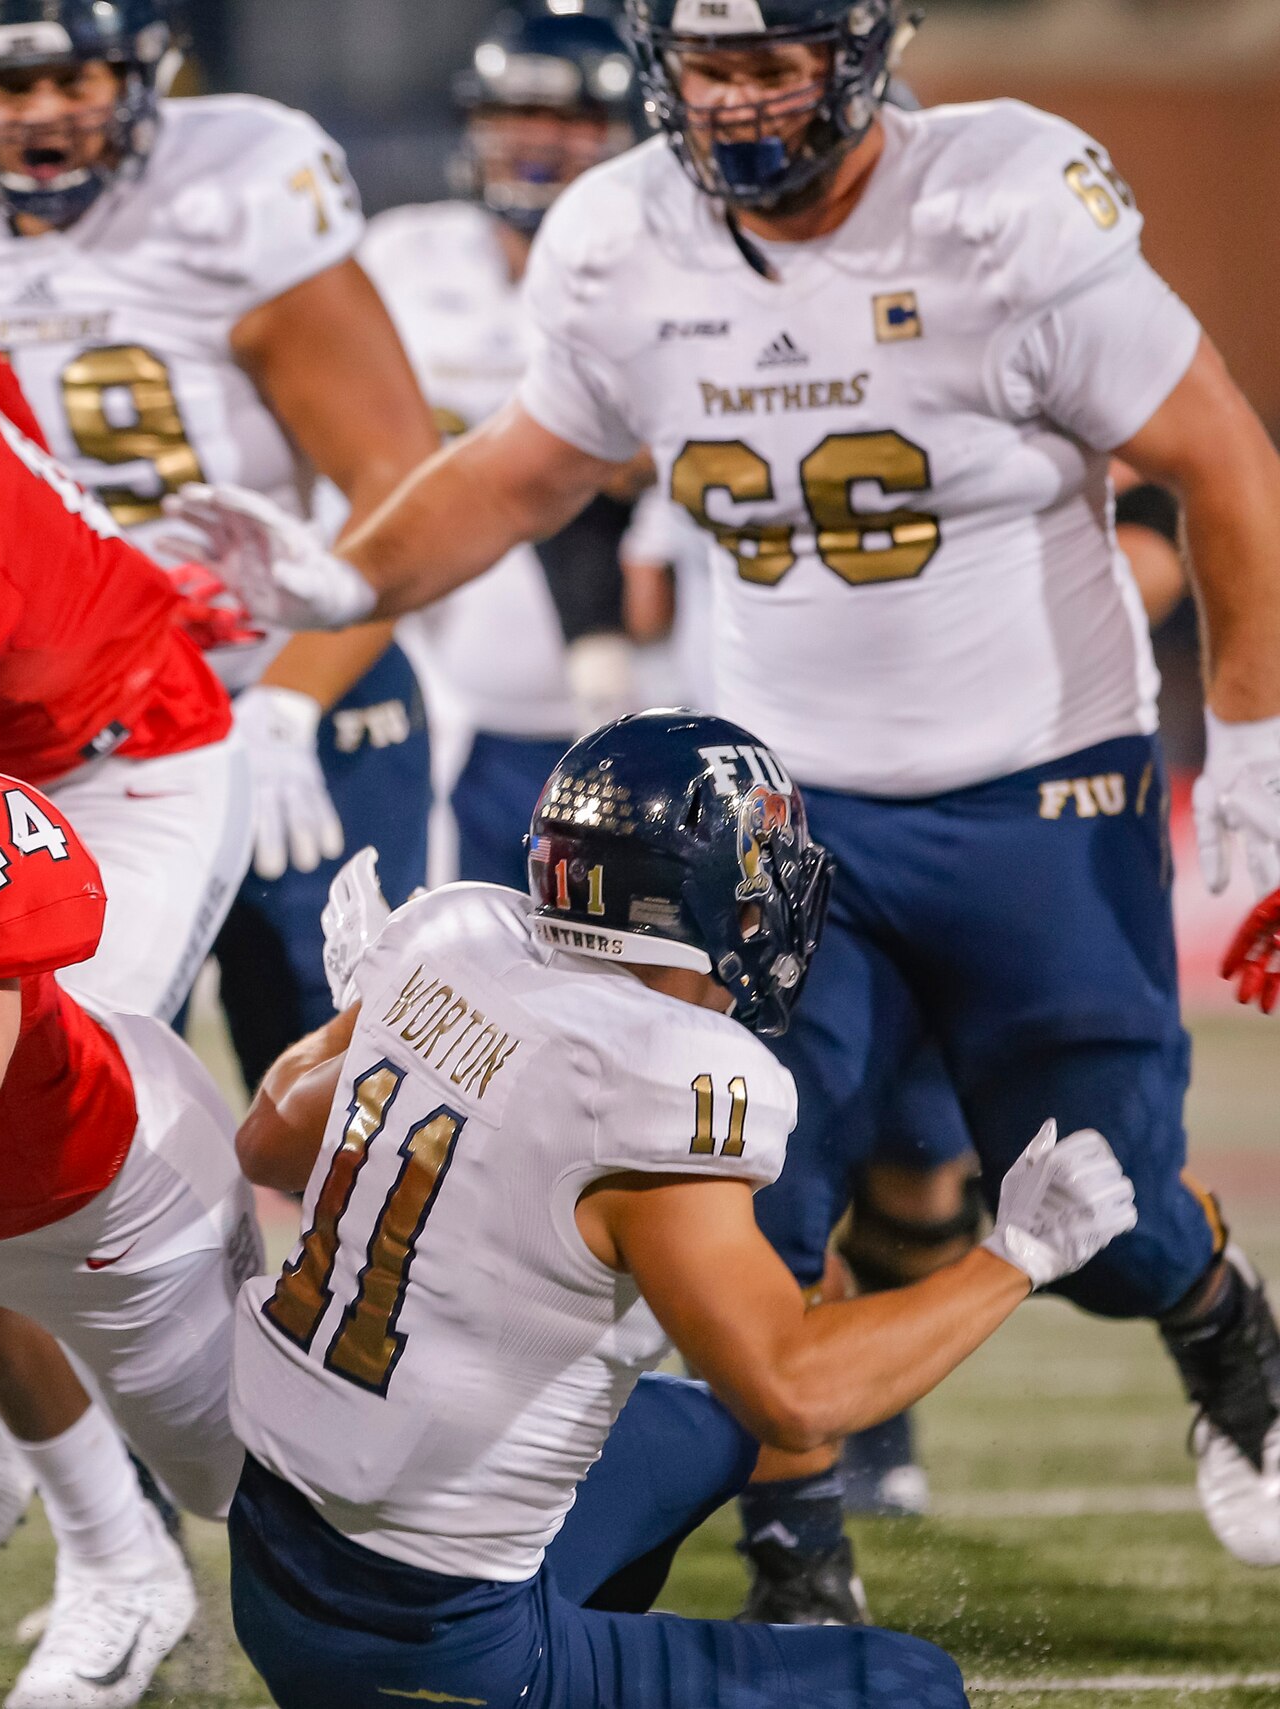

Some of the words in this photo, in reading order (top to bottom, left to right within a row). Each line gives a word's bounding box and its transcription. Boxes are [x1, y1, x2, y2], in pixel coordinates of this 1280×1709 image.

[697, 369, 870, 417] PANTHERS
[58, 341, 208, 527] 9
[671, 430, 940, 588] 66
[333, 699, 410, 753] FIU
[697, 744, 793, 797] FIU
[1038, 772, 1126, 820] FIU
[554, 859, 605, 916] 11
[381, 963, 522, 1101] WORTON
[689, 1072, 748, 1158] 11
[260, 1056, 469, 1401] 11
